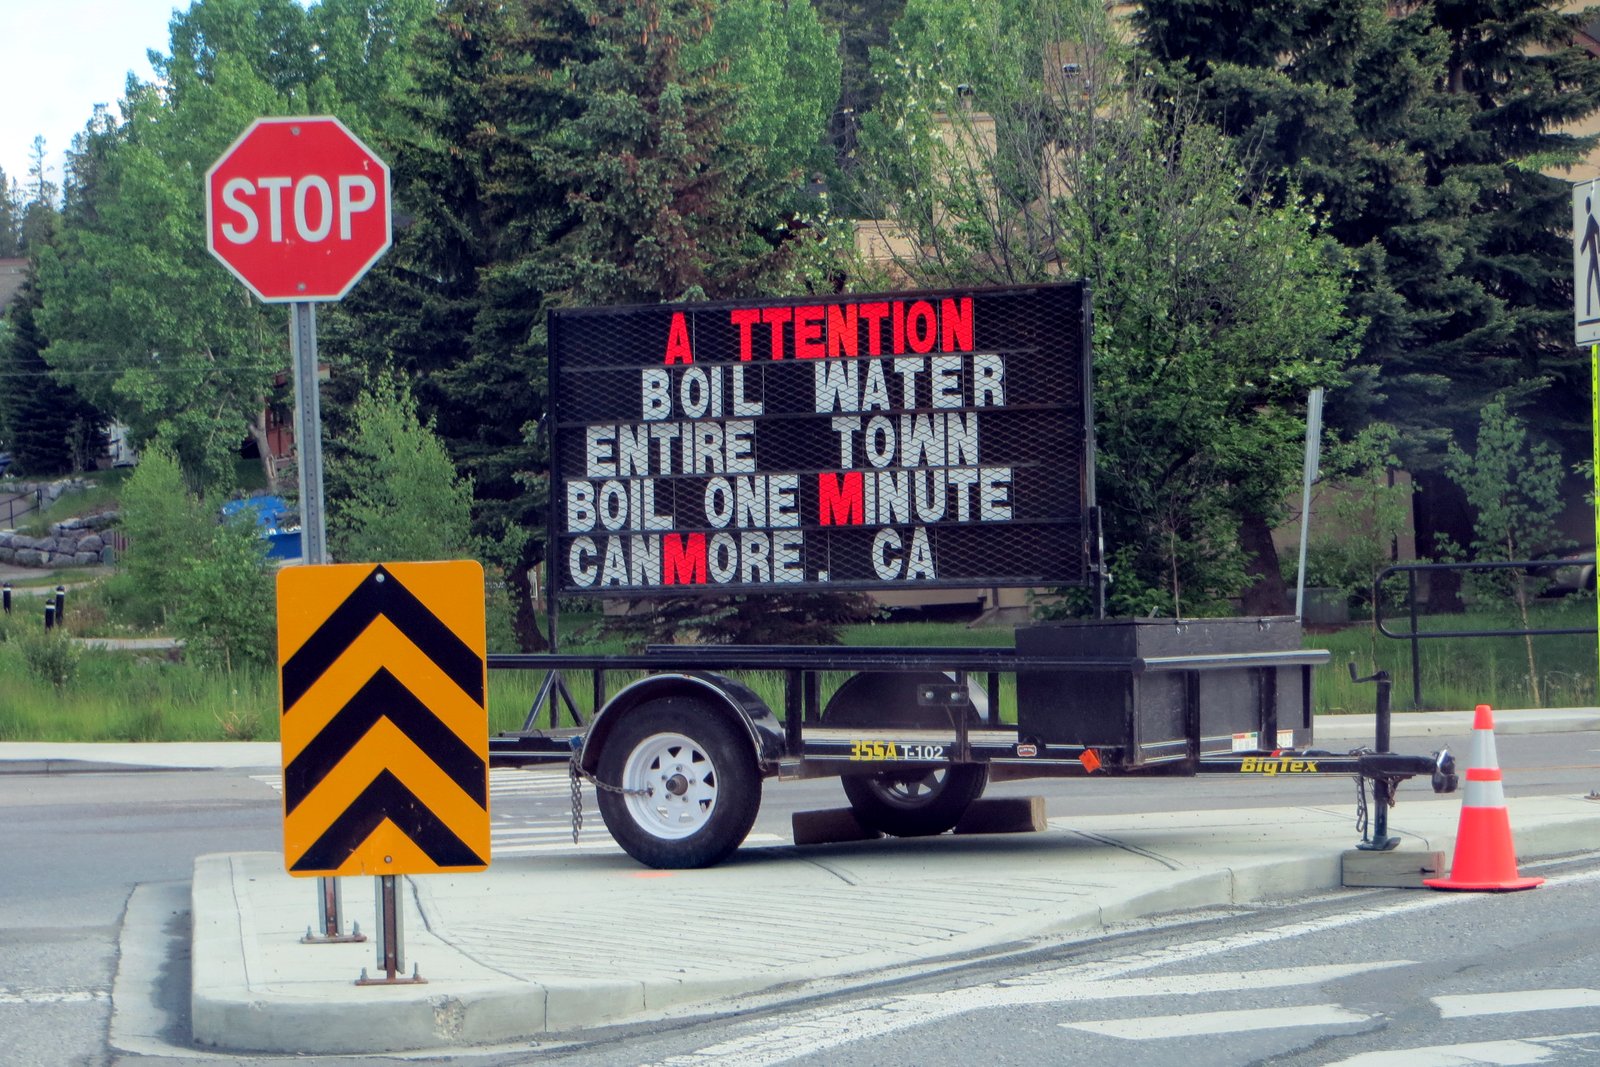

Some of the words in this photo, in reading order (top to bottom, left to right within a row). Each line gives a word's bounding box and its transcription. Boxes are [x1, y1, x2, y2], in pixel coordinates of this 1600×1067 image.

[221, 174, 377, 245] STOP
[642, 366, 763, 420] BOIL
[815, 353, 1005, 413] WATER
[586, 419, 757, 478] ENTIRE
[831, 411, 978, 469] TOWN
[567, 478, 674, 533] BOIL
[704, 474, 800, 529] ONE
[818, 467, 1013, 527] MINUTE
[901, 745, 944, 760] T-102
[1240, 756, 1318, 777] BigTex
